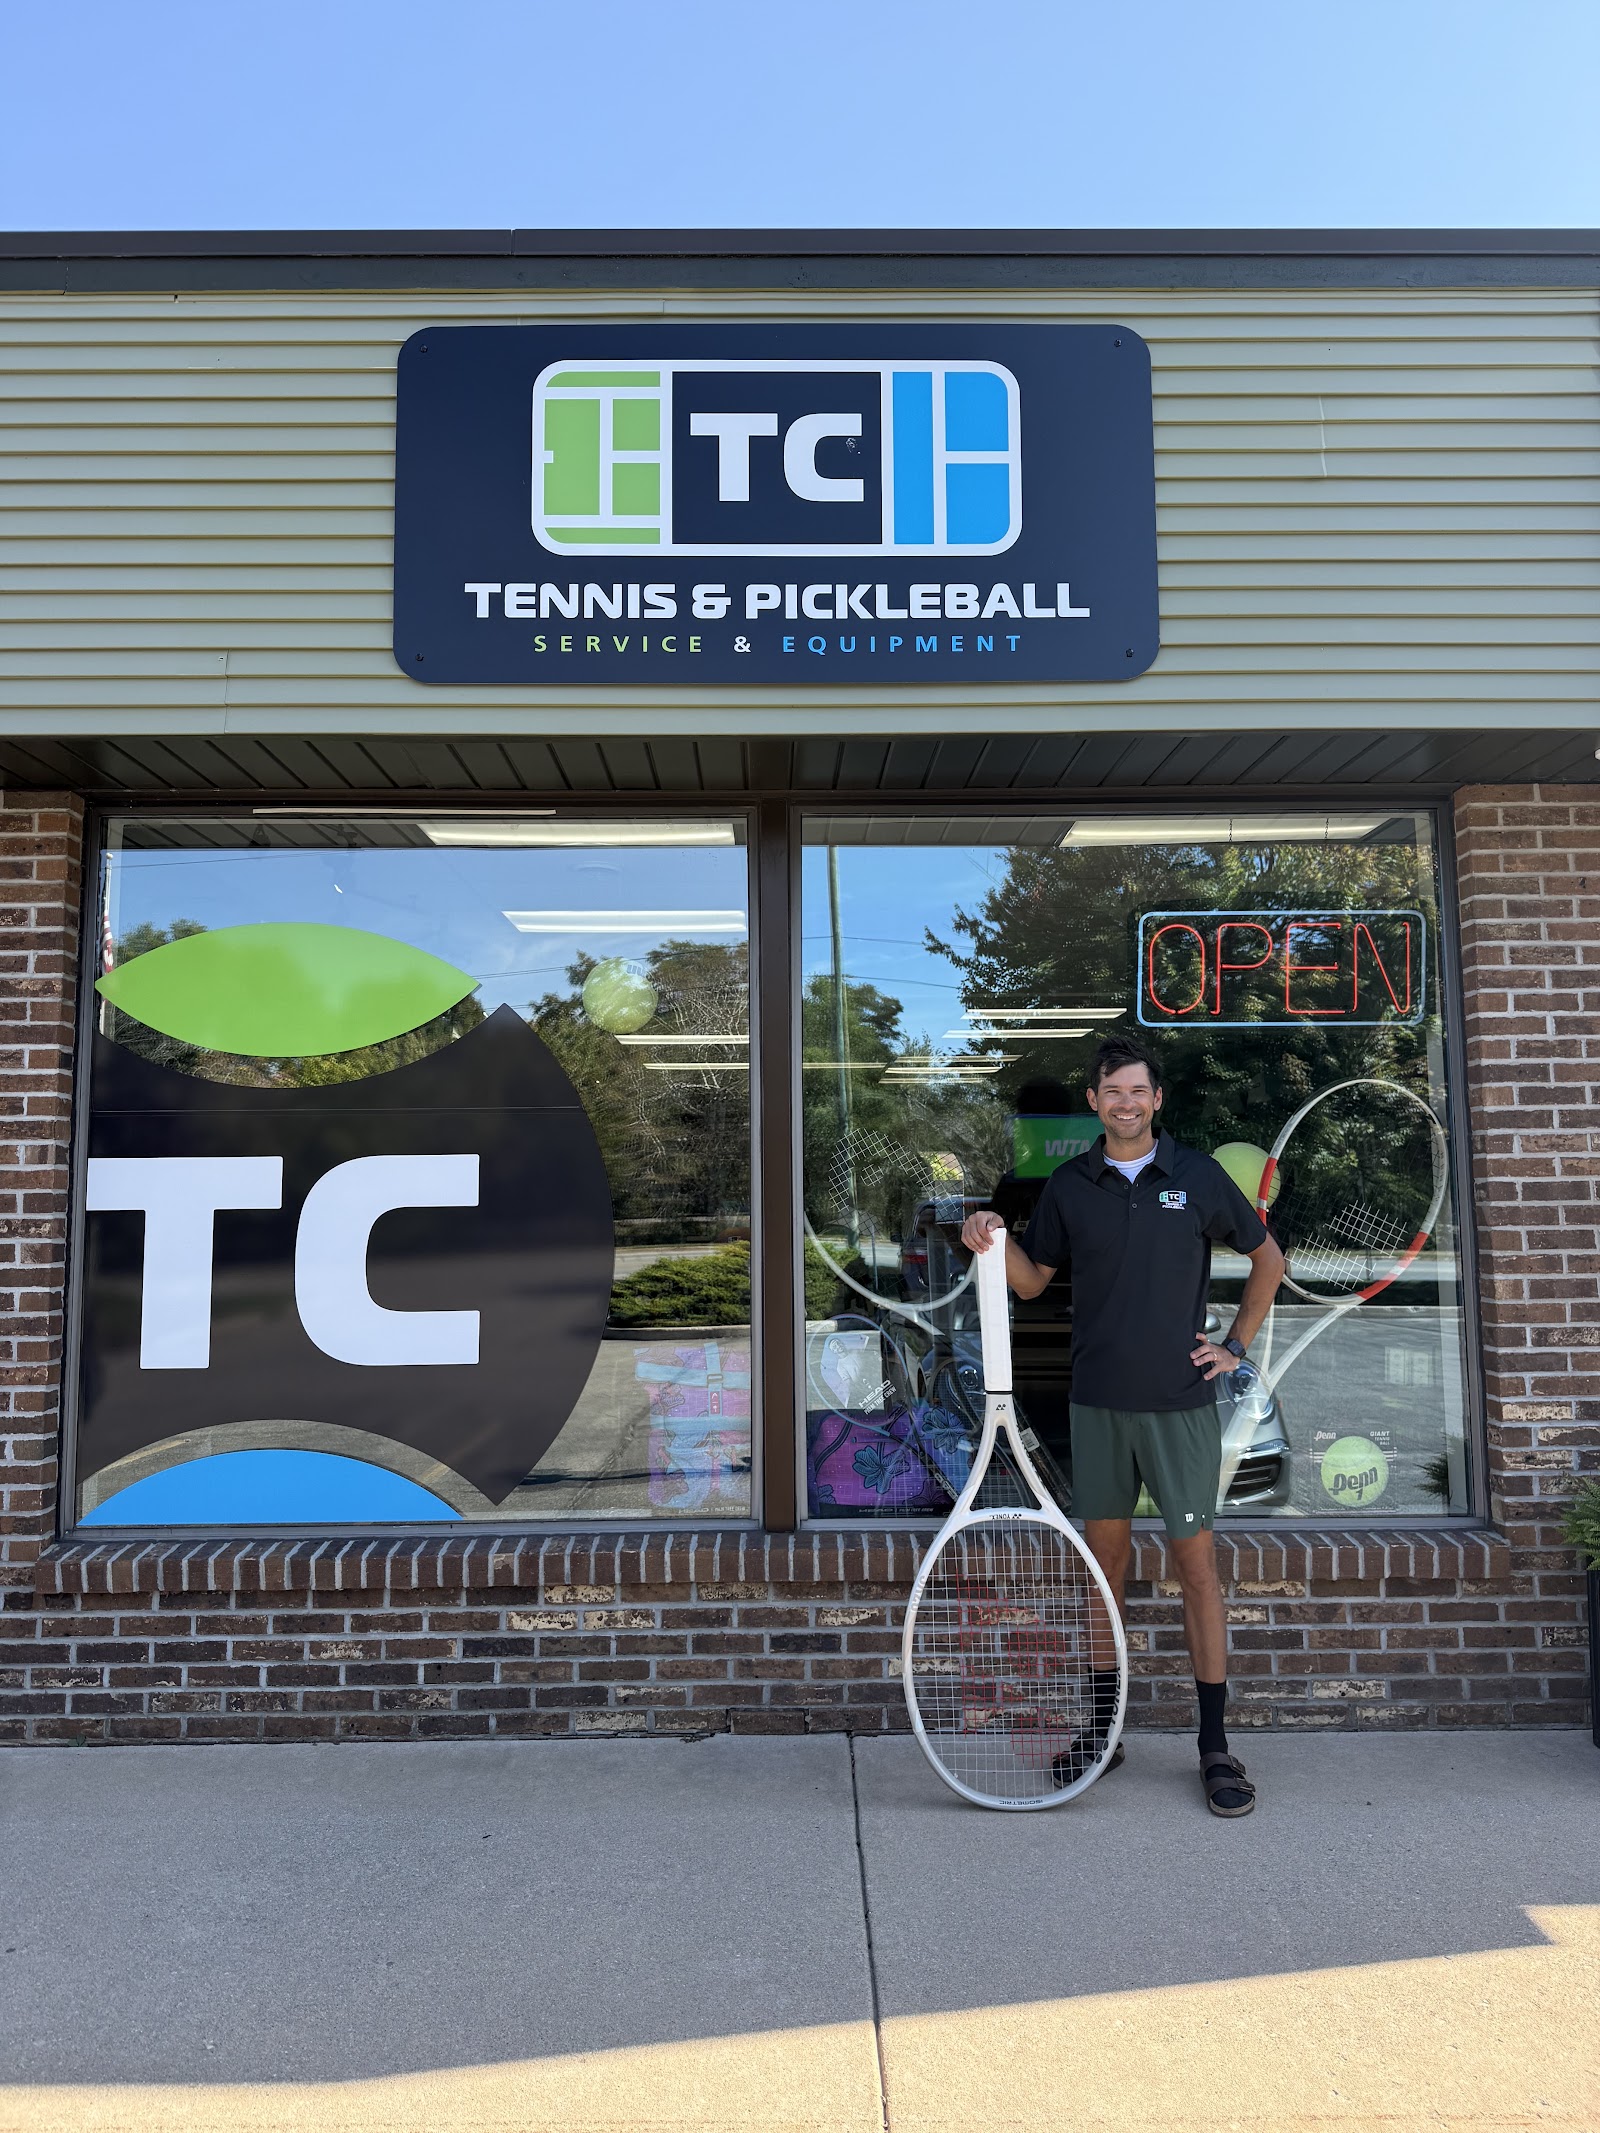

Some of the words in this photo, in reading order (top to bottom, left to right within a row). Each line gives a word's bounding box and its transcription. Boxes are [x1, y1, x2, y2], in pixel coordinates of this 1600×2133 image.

[690, 412, 864, 502] TC
[464, 582, 678, 620] TENNIS
[691, 583, 732, 619] &
[745, 582, 1091, 620] PICKLEBALL
[533, 635, 702, 653] SERVICE
[733, 635, 752, 653] &
[782, 634, 1021, 655] EQUIPMENT
[1148, 923, 1411, 1015] OPEN
[86, 1154, 480, 1369] TC
[858, 1379, 891, 1408] HEAD
[883, 1385, 897, 1399] CREW
